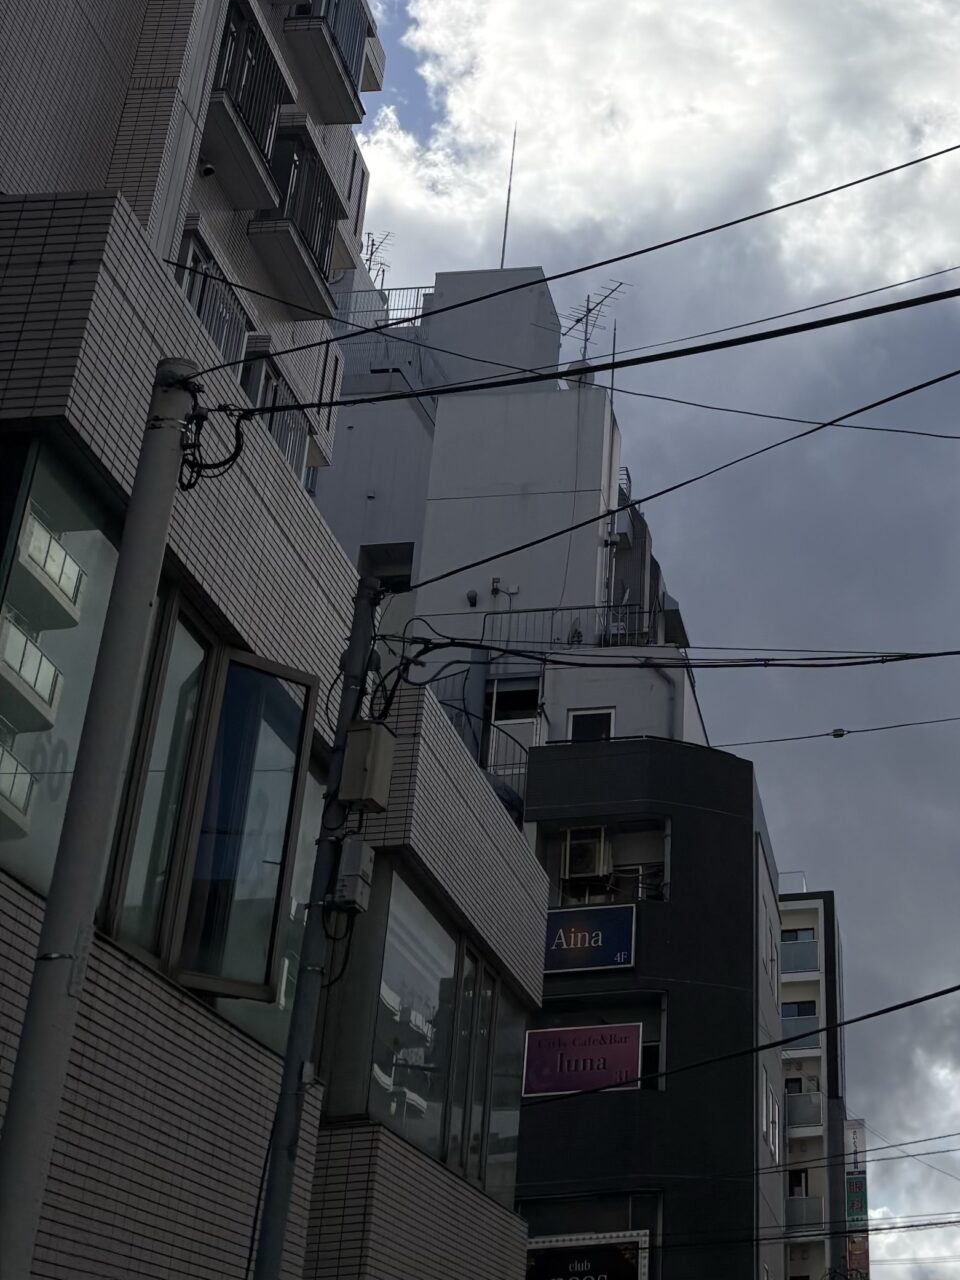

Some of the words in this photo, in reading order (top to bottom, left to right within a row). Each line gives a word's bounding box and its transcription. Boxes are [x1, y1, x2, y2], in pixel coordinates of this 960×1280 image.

[551, 928, 603, 950] Aina
[613, 951, 628, 963] 4F
[557, 1052, 607, 1073] luna
[568, 1259, 591, 1272] club
